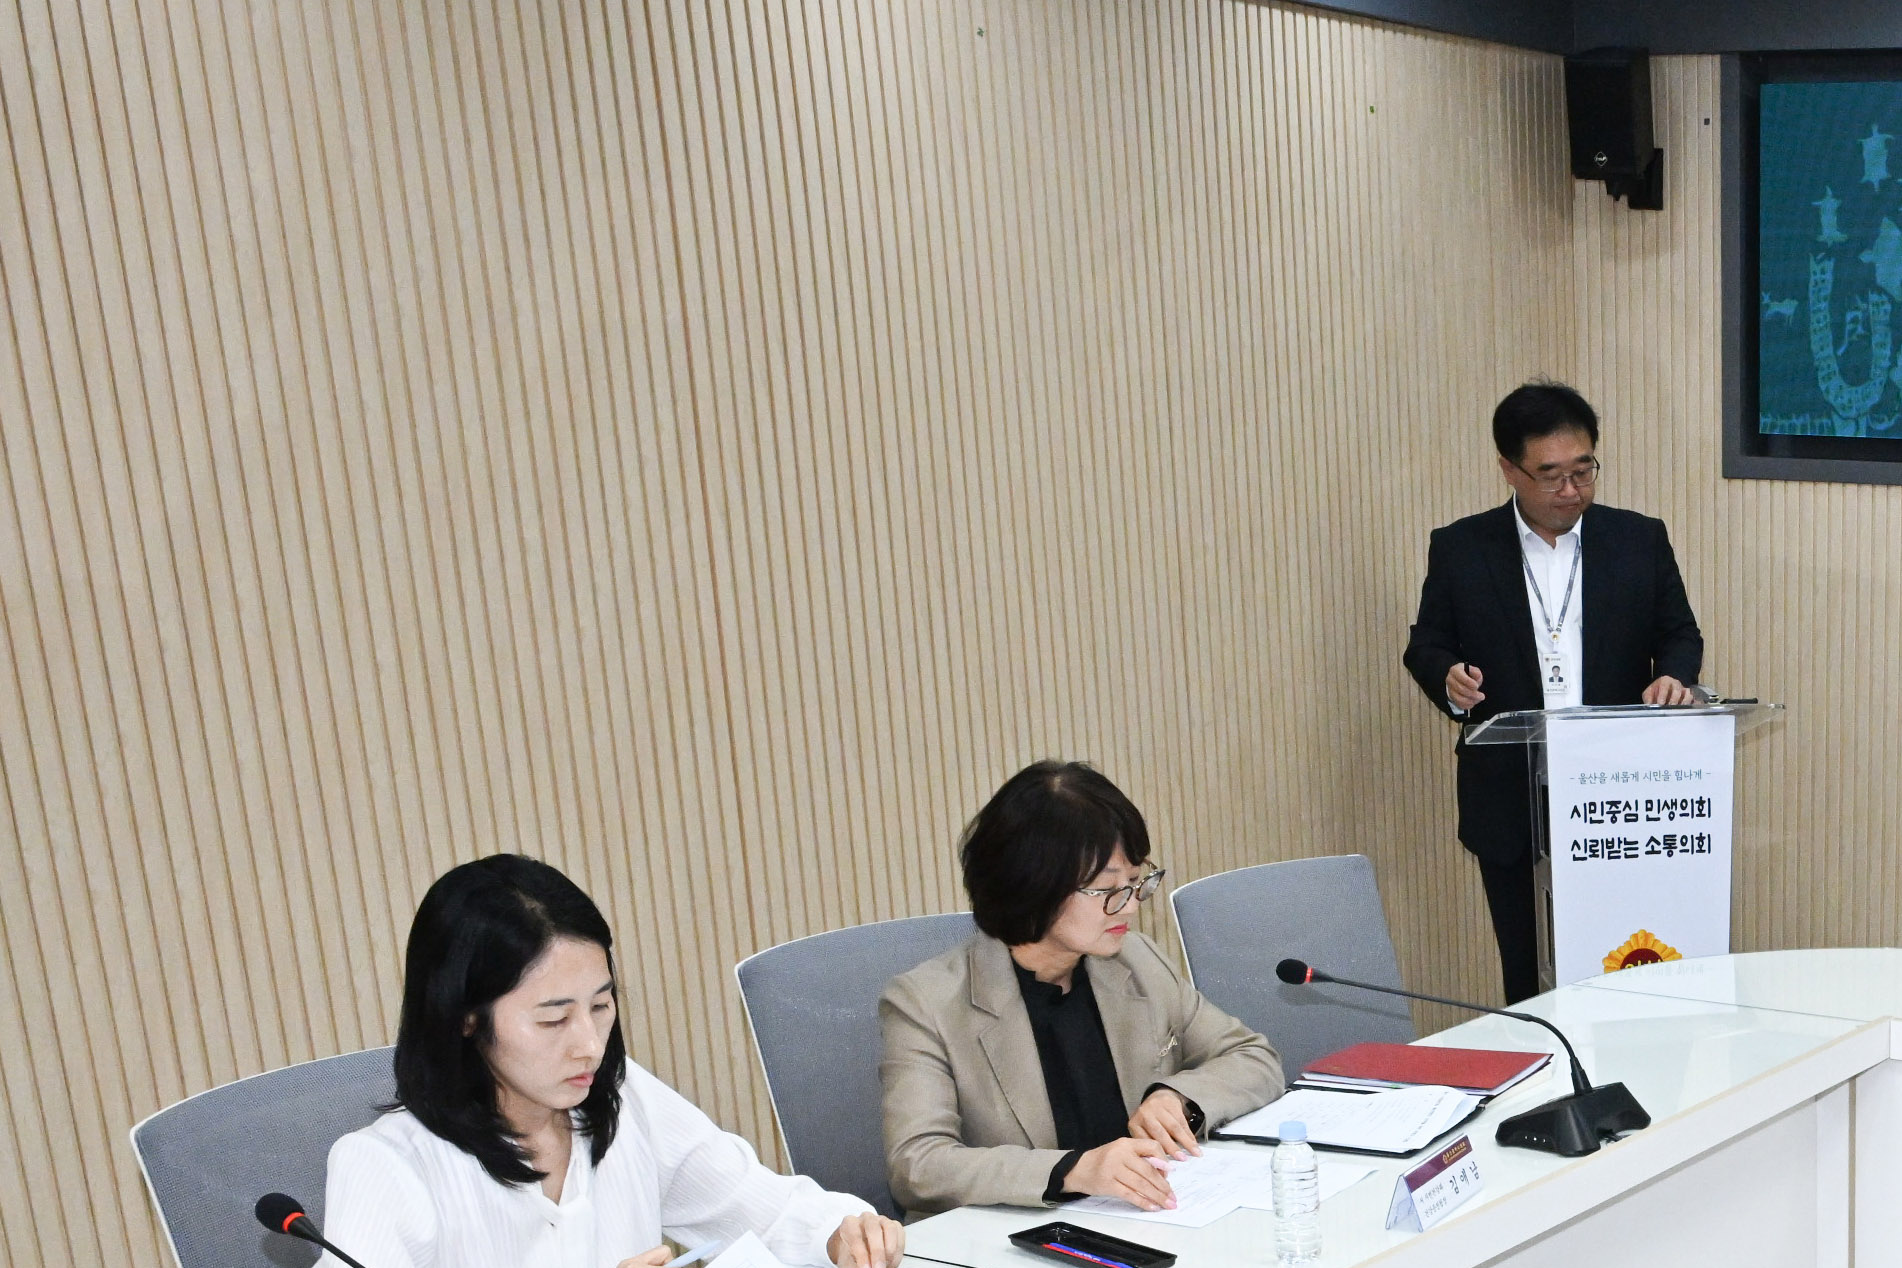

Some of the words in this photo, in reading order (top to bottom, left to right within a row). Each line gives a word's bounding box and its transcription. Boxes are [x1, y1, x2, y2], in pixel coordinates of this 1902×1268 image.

[1578, 771, 1608, 785] 울산을
[1610, 771, 1640, 784] 새롭게
[1642, 769, 1672, 782] 시민을
[1674, 768, 1702, 782] 힘나게
[1570, 799, 1639, 825] 시민중심
[1645, 795, 1712, 822] 민생의회
[1570, 836, 1640, 862] 신뢰받는
[1644, 832, 1711, 858] 소통의회
